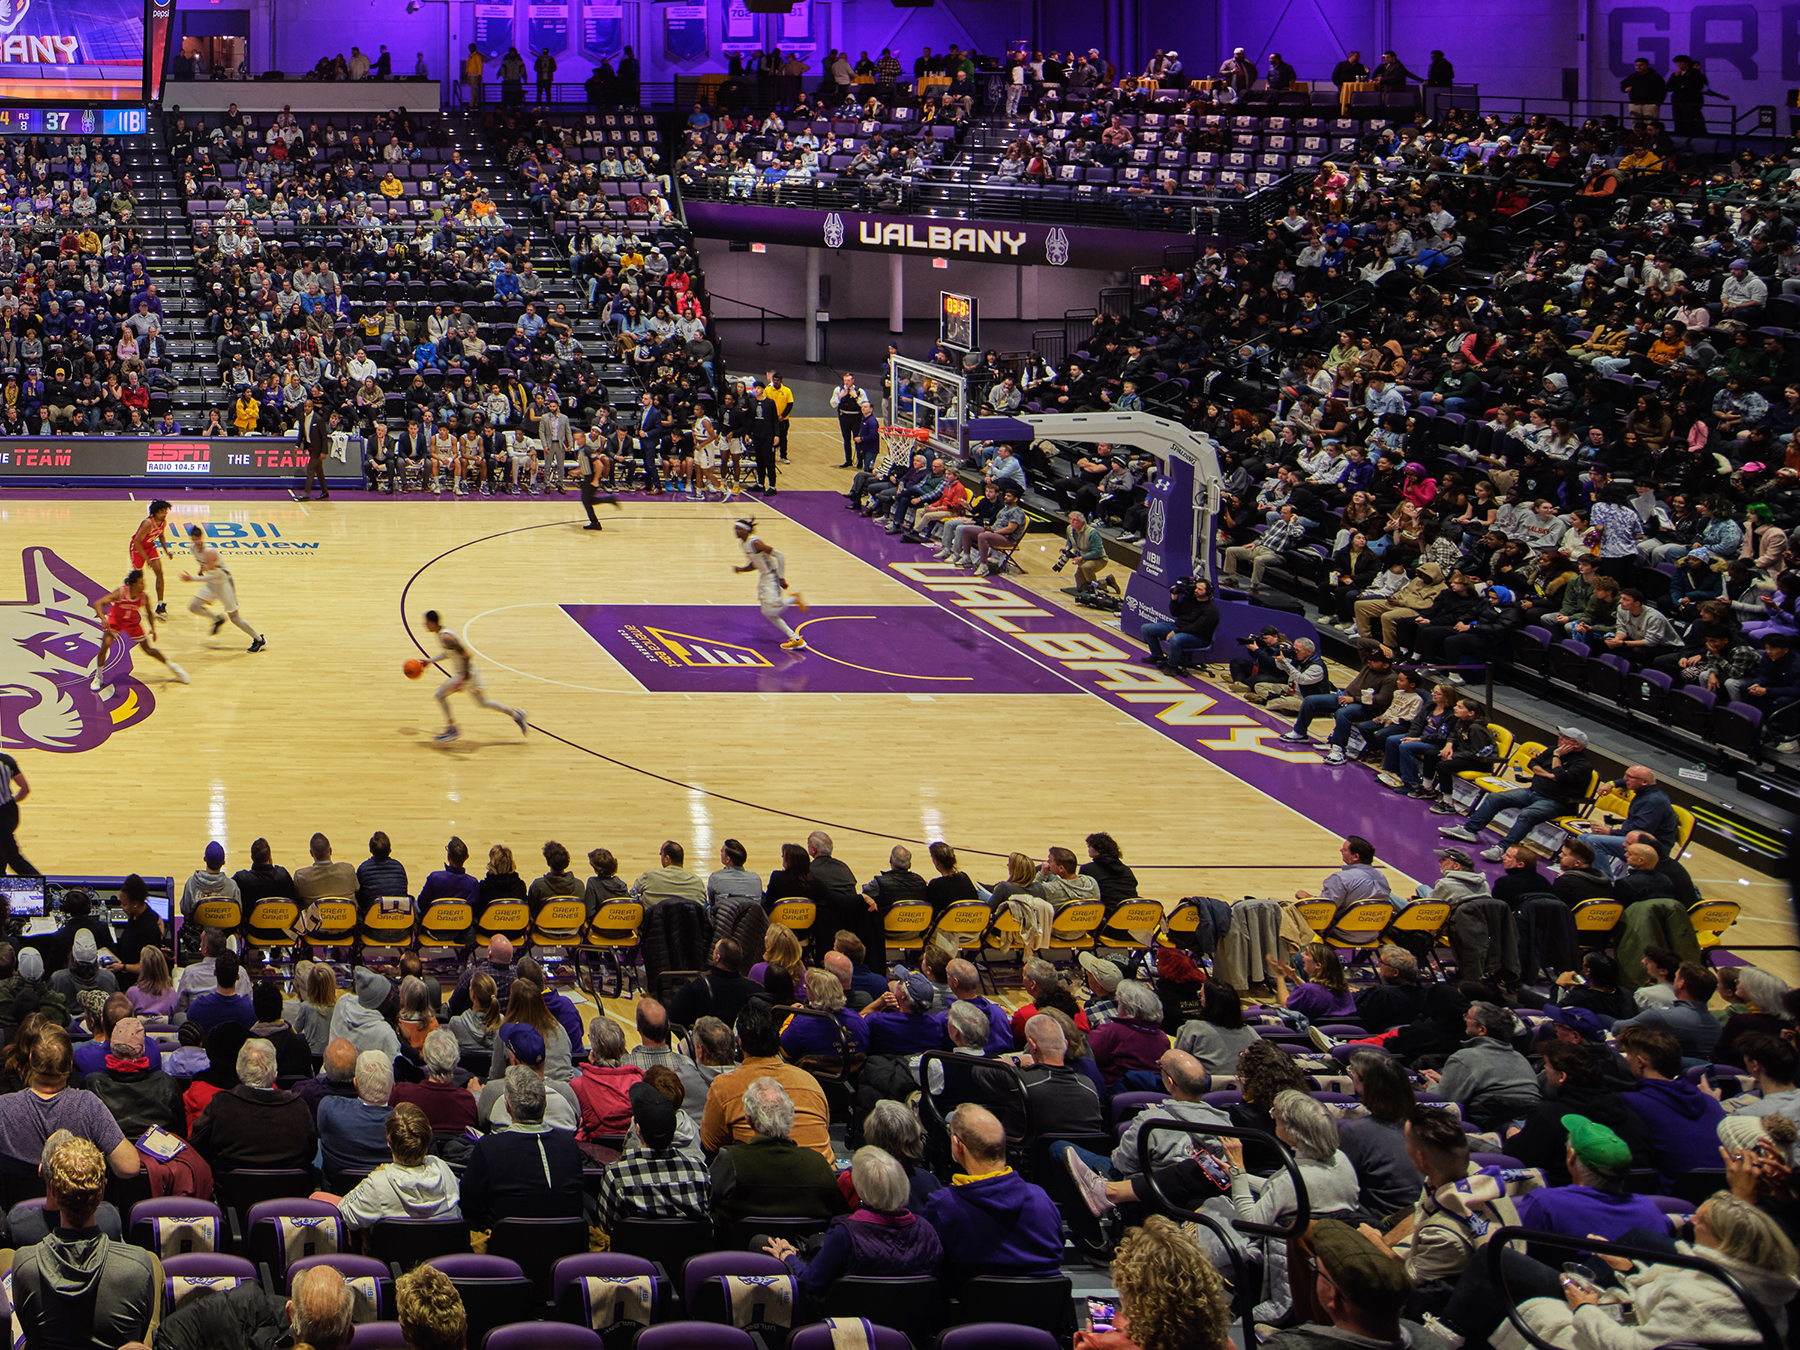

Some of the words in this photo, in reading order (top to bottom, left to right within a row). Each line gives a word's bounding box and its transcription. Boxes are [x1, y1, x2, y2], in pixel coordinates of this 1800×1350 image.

[153, 9, 170, 19] pepsi
[731, 9, 751, 17] 702
[20, 121, 28, 131] 8
[46, 112, 70, 131] 37
[859, 221, 1027, 256] UALBANY
[14, 448, 72, 466] TEAM
[147, 443, 210, 461] ESPN
[227, 454, 250, 465] THE
[254, 450, 311, 468] TEAM
[1170, 443, 1197, 465] SPALDING
[148, 463, 172, 471] RADIO
[174, 463, 195, 471] 104.5
[197, 463, 209, 471] FM
[1138, 608, 1159, 624] Mutual
[617, 629, 658, 663] CONFERENCE
[888, 562, 1325, 764] UALBANY
